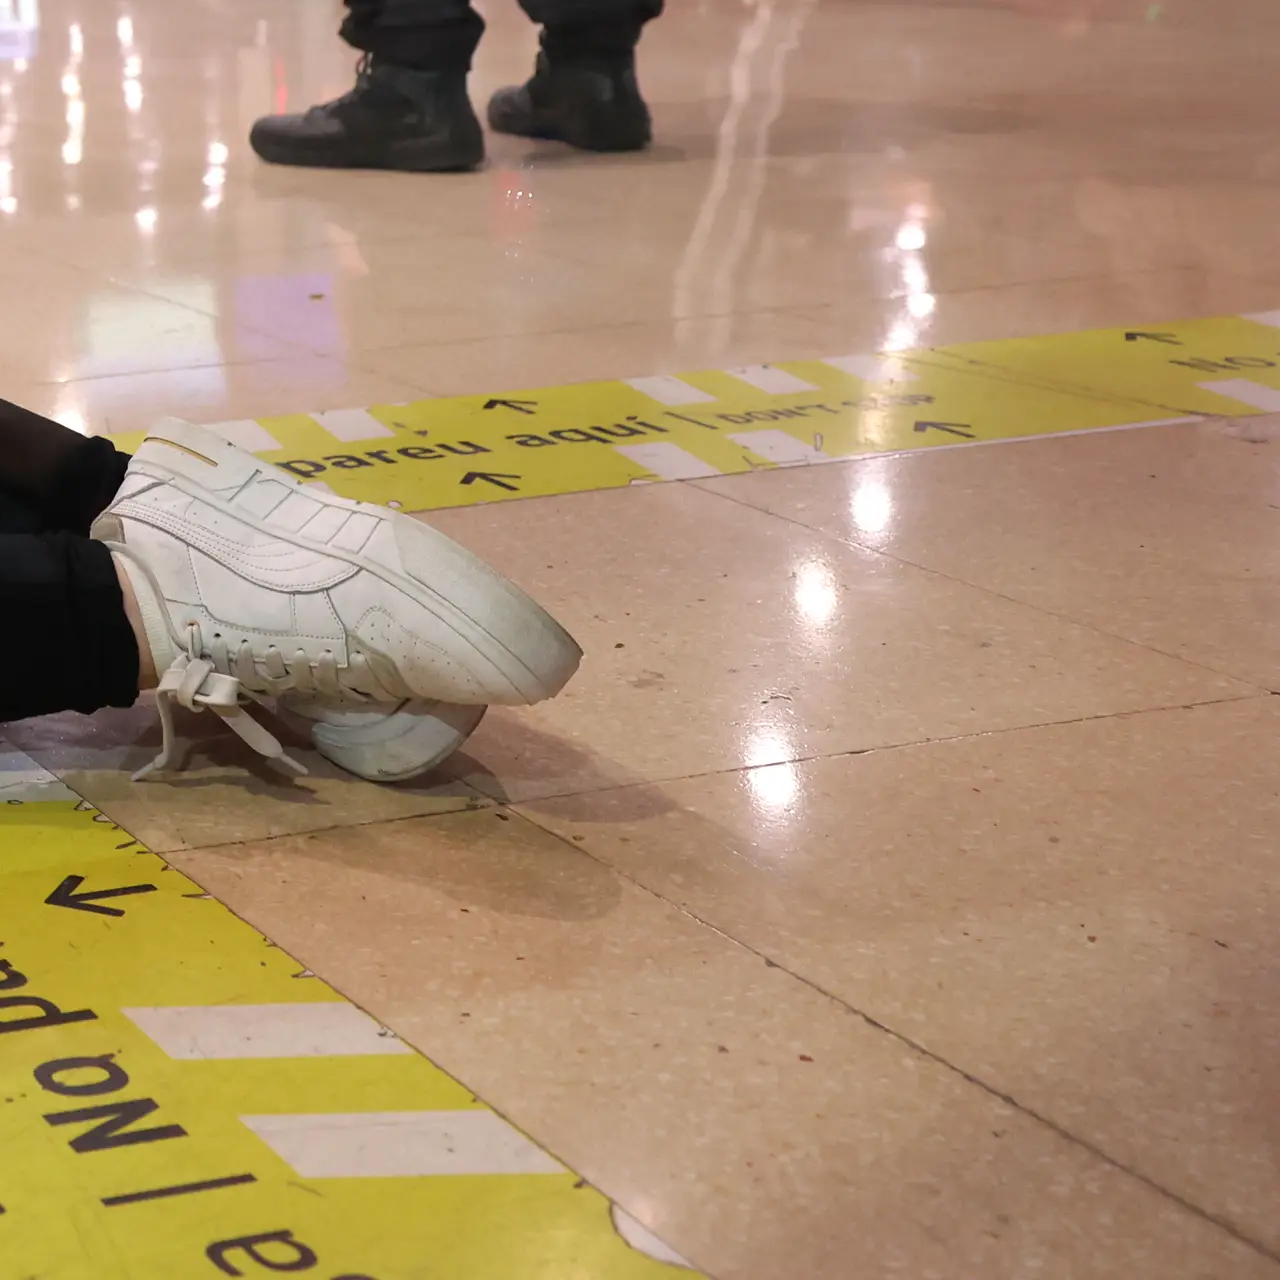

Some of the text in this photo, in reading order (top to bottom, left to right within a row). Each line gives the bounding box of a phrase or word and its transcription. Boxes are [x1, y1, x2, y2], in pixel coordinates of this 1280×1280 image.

[274, 440, 492, 479] pareu
[505, 415, 670, 448] aquí
[32, 1052, 190, 1155] No
